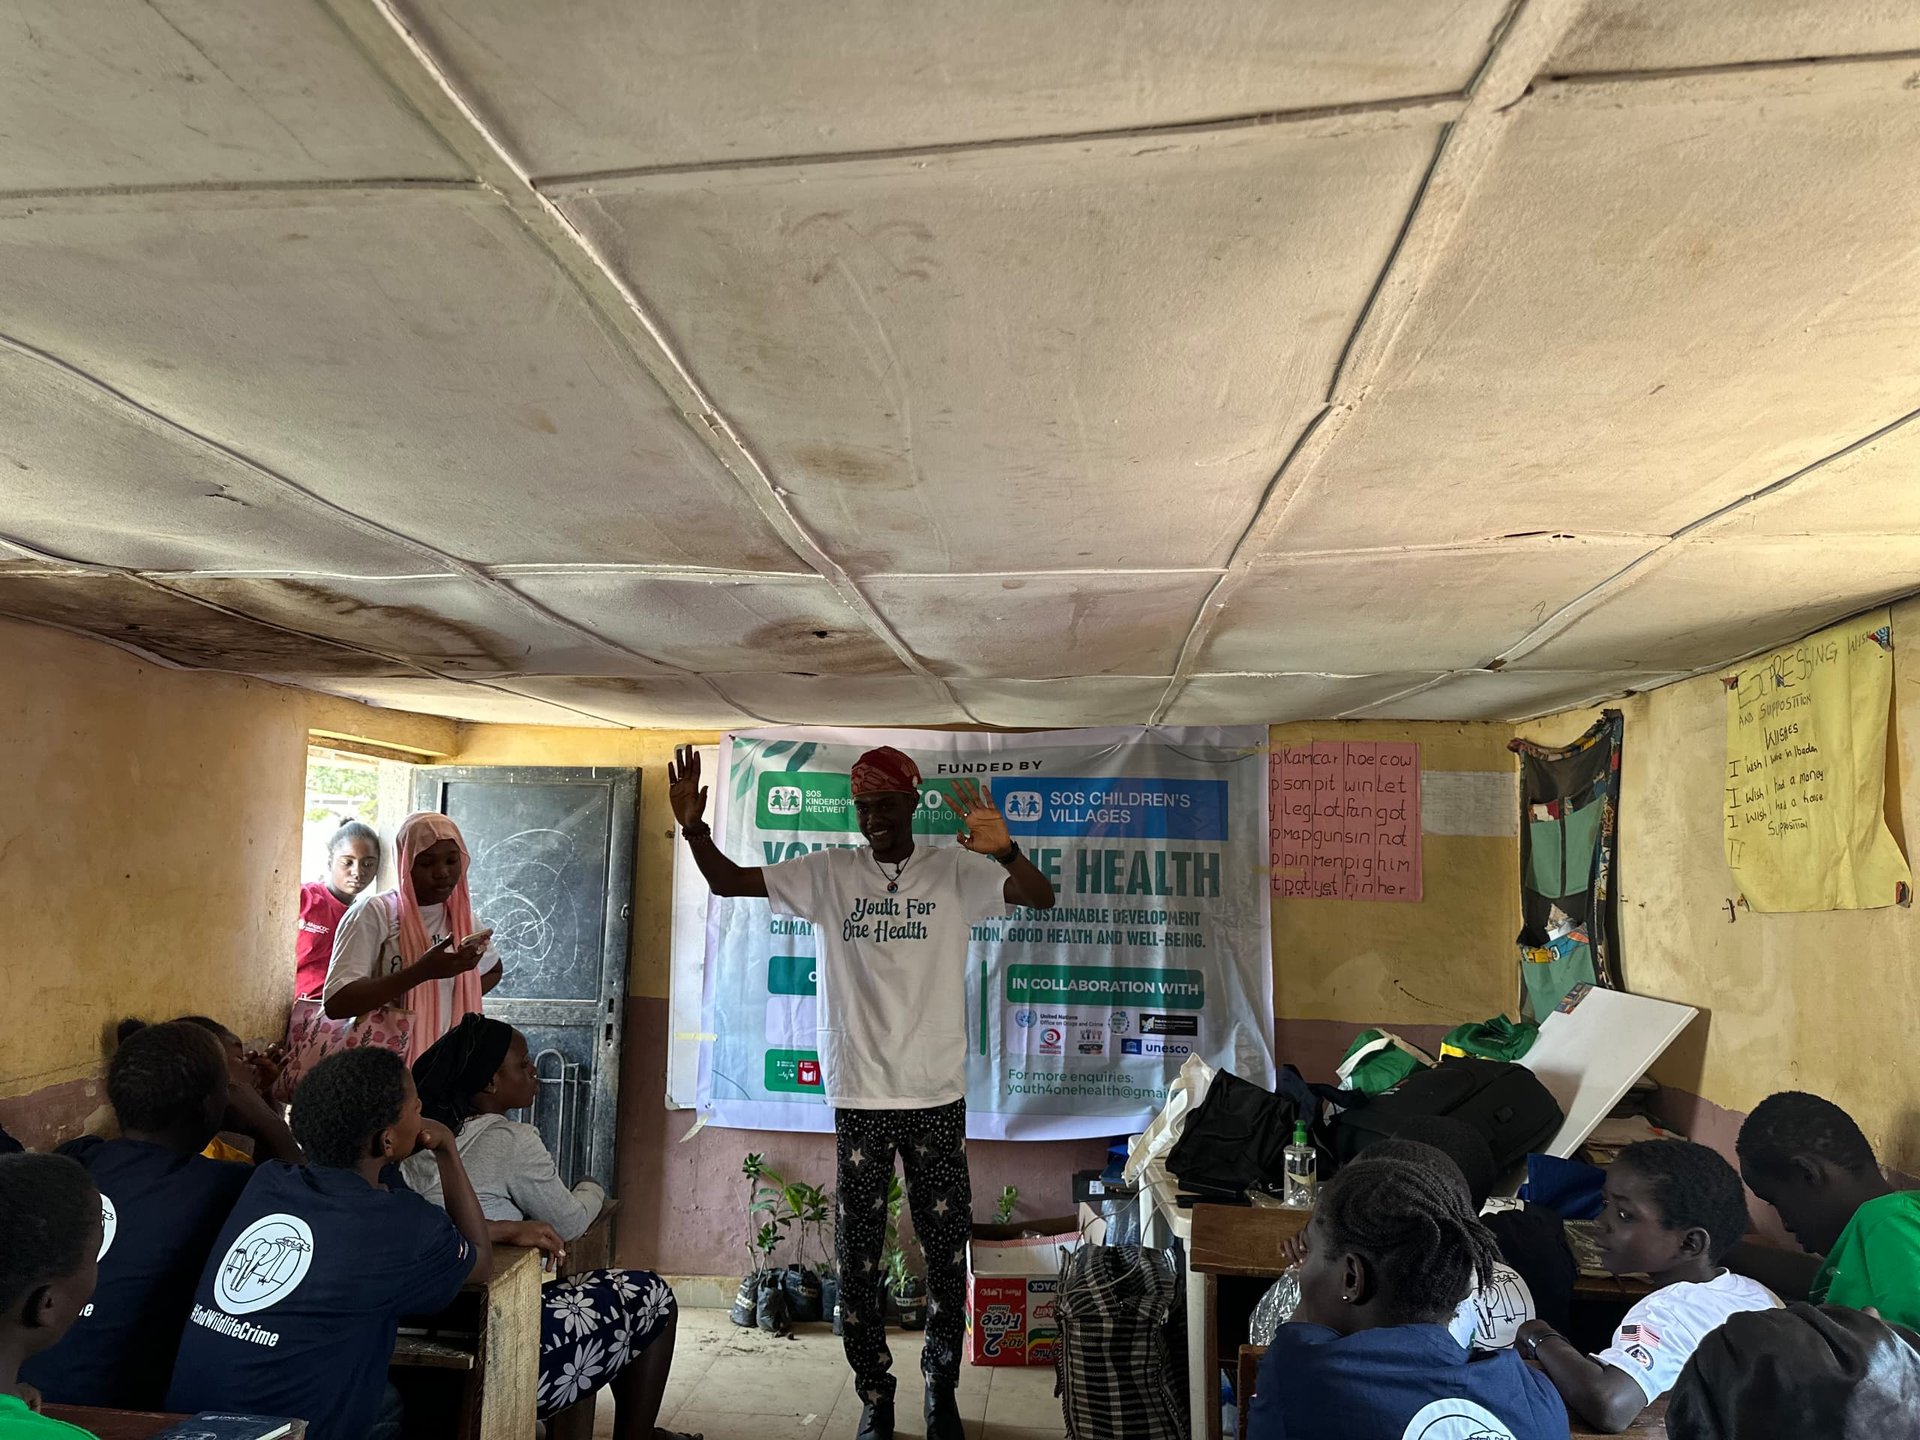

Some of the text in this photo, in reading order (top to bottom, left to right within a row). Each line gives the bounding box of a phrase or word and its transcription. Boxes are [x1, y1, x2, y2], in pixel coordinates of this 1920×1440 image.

[1313, 753, 1338, 764] car
[1346, 744, 1375, 766] hoe
[1380, 755, 1411, 766] cow
[937, 760, 1042, 774] FUNDED BY
[1729, 759, 1741, 779] I
[805, 789, 822, 798] SOS
[1283, 779, 1310, 790] son
[1315, 773, 1335, 796] pit
[1345, 781, 1372, 792] win
[805, 798, 855, 807] KINDERDÖR
[1050, 792, 1191, 808] SOS CHILDREN'S
[1726, 787, 1741, 809] I
[805, 806, 846, 814] WELTWEIT
[1050, 809, 1131, 823] VILLAGES
[1346, 798, 1372, 818] fan
[1376, 799, 1406, 825] got
[1727, 815, 1739, 829] I
[1313, 830, 1342, 849] gun
[1345, 832, 1370, 844] sin
[1379, 825, 1407, 846] not
[1285, 852, 1309, 869] pin
[1344, 854, 1372, 877] pig
[1378, 850, 1410, 872] him
[1075, 849, 1220, 898] HEALTH
[1285, 872, 1311, 896] pot
[1314, 873, 1337, 897] yet
[1345, 874, 1373, 893] fin
[1378, 876, 1406, 894] her
[851, 898, 936, 922] Youth For
[1026, 907, 1108, 923] SUSTAINABLE
[1113, 909, 1200, 926] DEVELOPMENT
[770, 920, 814, 936] CLIMAT
[843, 919, 928, 942] One Health
[970, 927, 1206, 948] TION, GOOD HEALTH AND WELL-BEING.
[1012, 978, 1199, 995] IN COLLABORATION WITH
[1146, 1042, 1188, 1054] unesco
[1009, 1069, 1134, 1084] For more enquiries:
[1008, 1083, 1172, 1099] youth4onehealth@gmail
[190, 1303, 280, 1347] #EndWildlifeCrime
[982, 1313, 1021, 1330] Free
[984, 1333, 1003, 1355] 2
